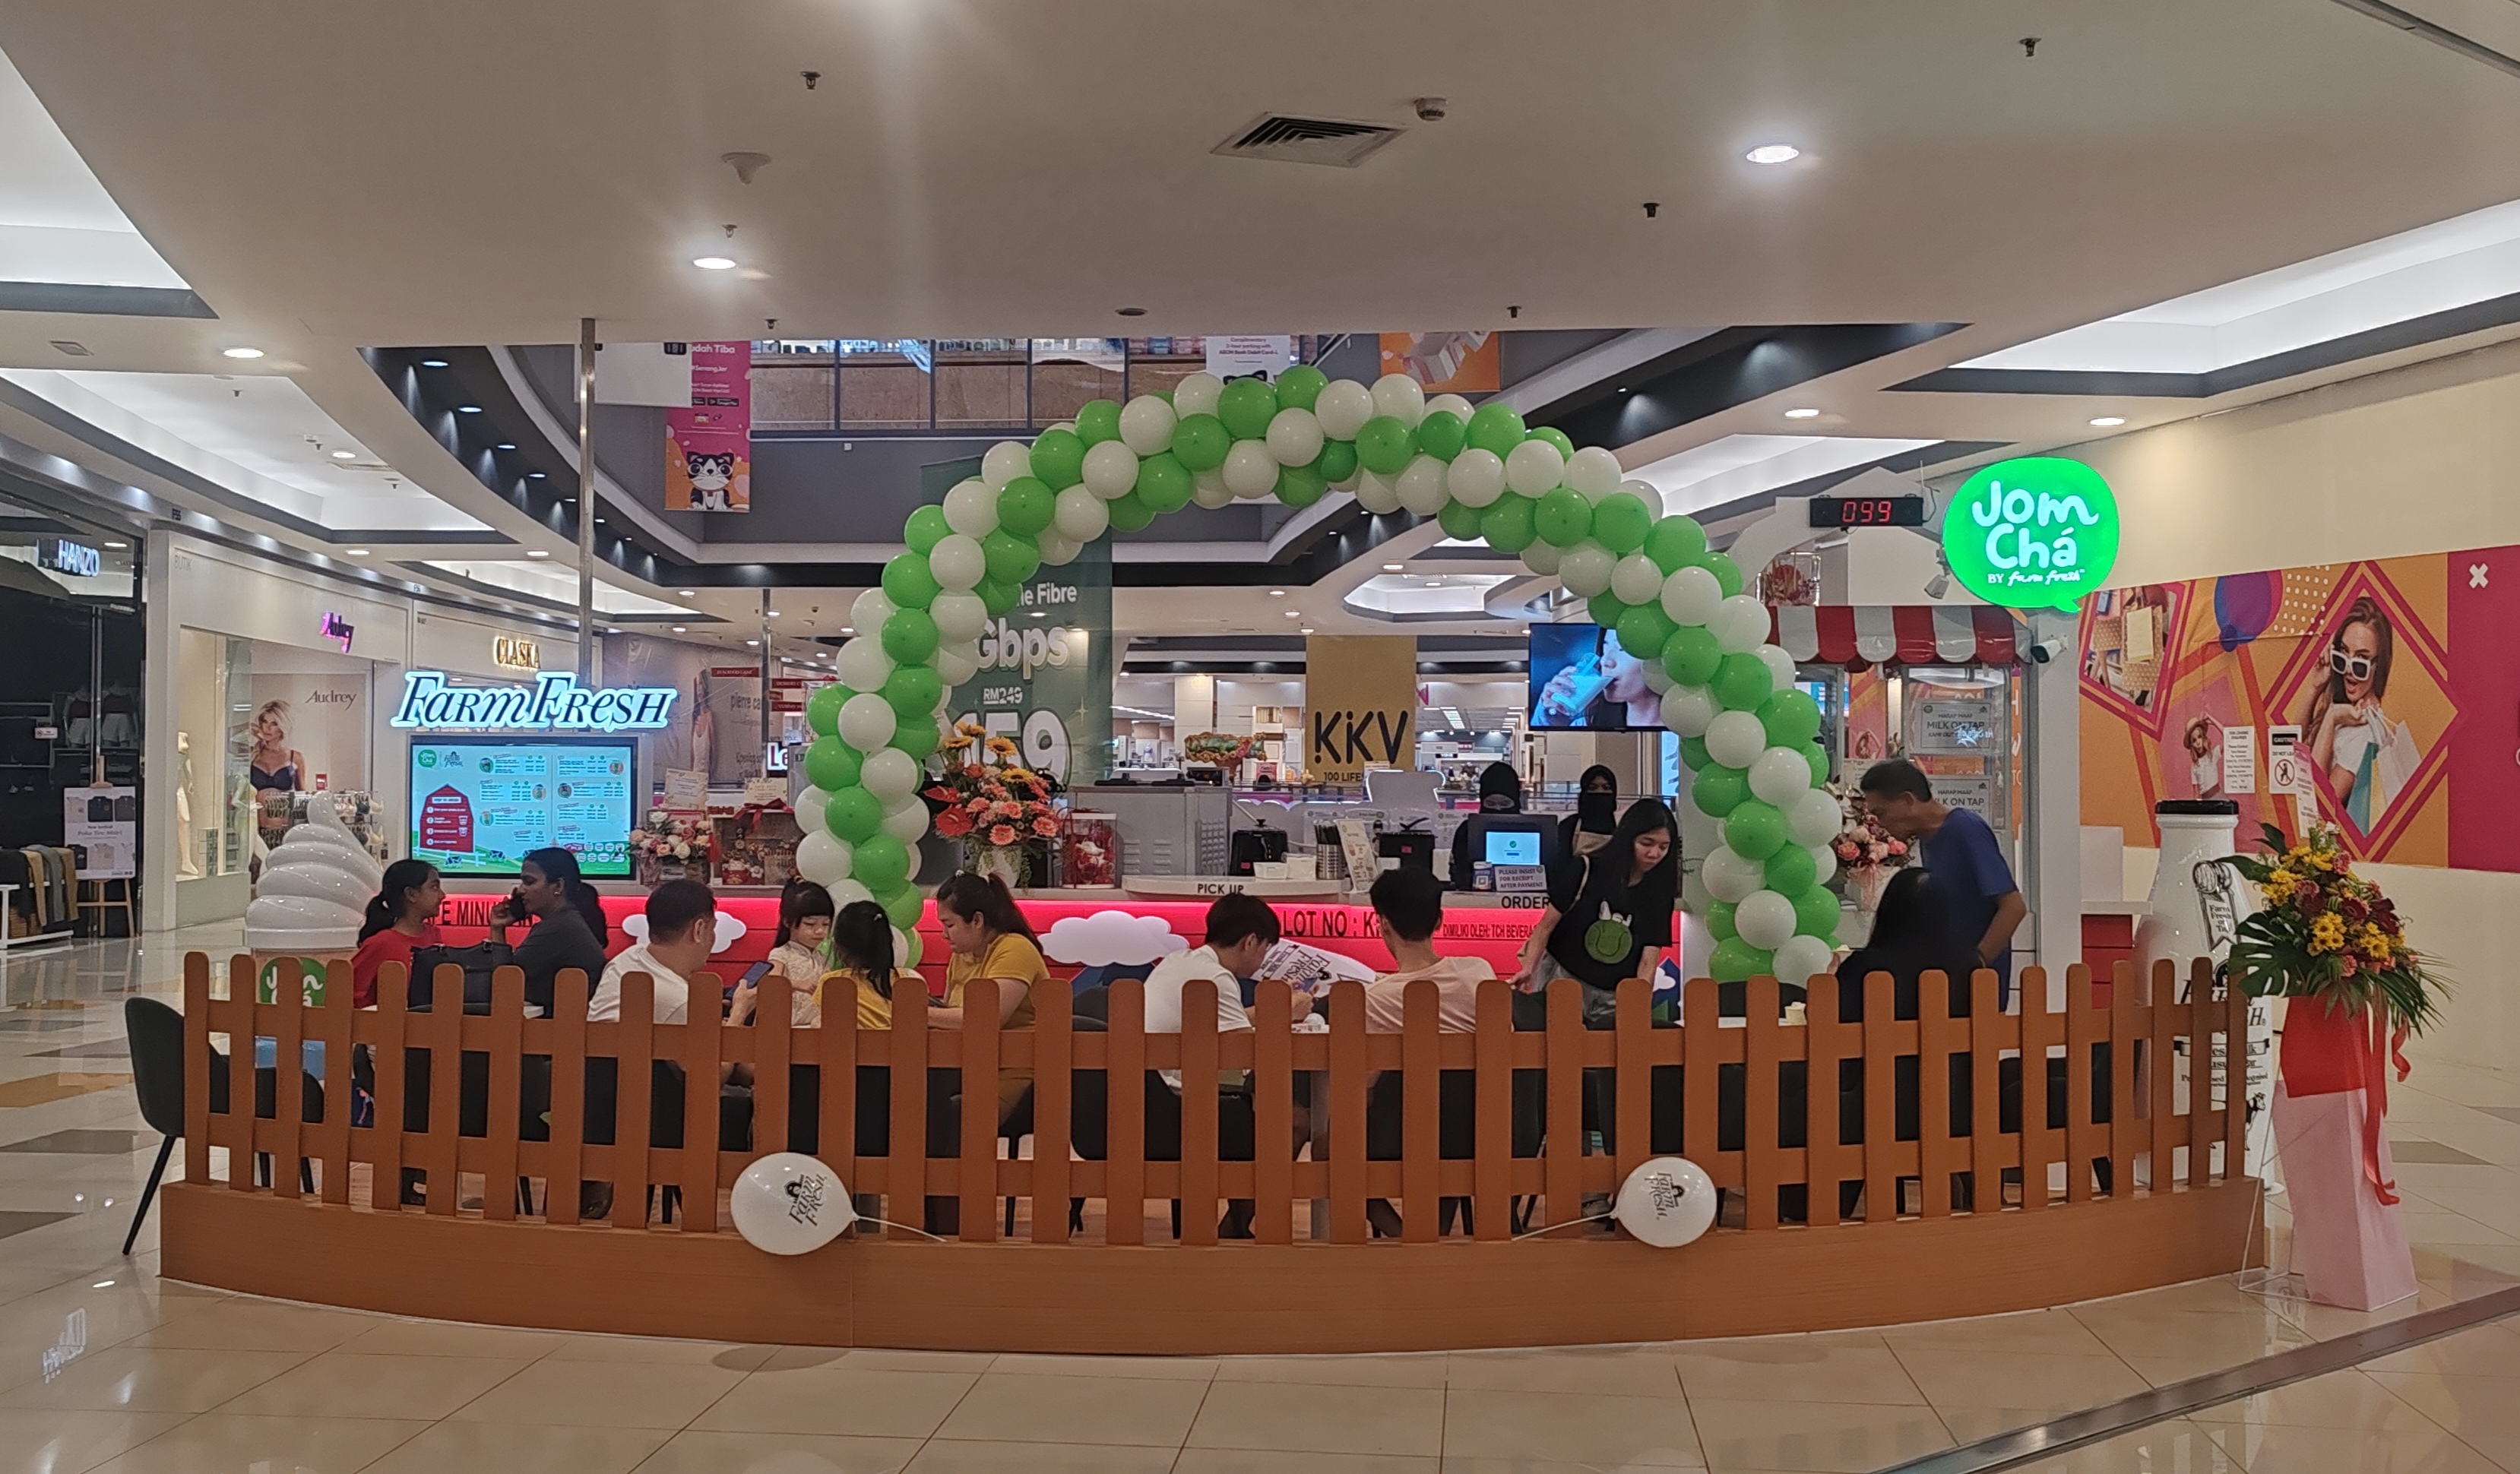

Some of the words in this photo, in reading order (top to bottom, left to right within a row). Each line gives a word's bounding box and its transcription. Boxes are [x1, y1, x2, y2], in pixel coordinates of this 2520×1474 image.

[1842, 501, 1892, 523] 099
[1971, 479, 2100, 527] Jom
[1985, 523, 2078, 569] Chá
[59, 539, 100, 577] HANZO
[1987, 573, 2005, 584] BY
[1037, 582, 1078, 606] Fibre
[496, 638, 541, 669] CLASKA
[977, 617, 1069, 680] Gbps
[305, 689, 357, 712] Audrey
[983, 686, 1023, 705] RM249
[1324, 771, 1340, 782] 100
[1950, 798, 1965, 806] ON
[1967, 798, 1985, 806] TAP
[1197, 884, 1225, 894] PICK
[1229, 884, 1244, 894] UP
[1501, 895, 1550, 909] ORDER
[1283, 910, 1317, 938] LOT
[1322, 910, 1347, 938] NO
